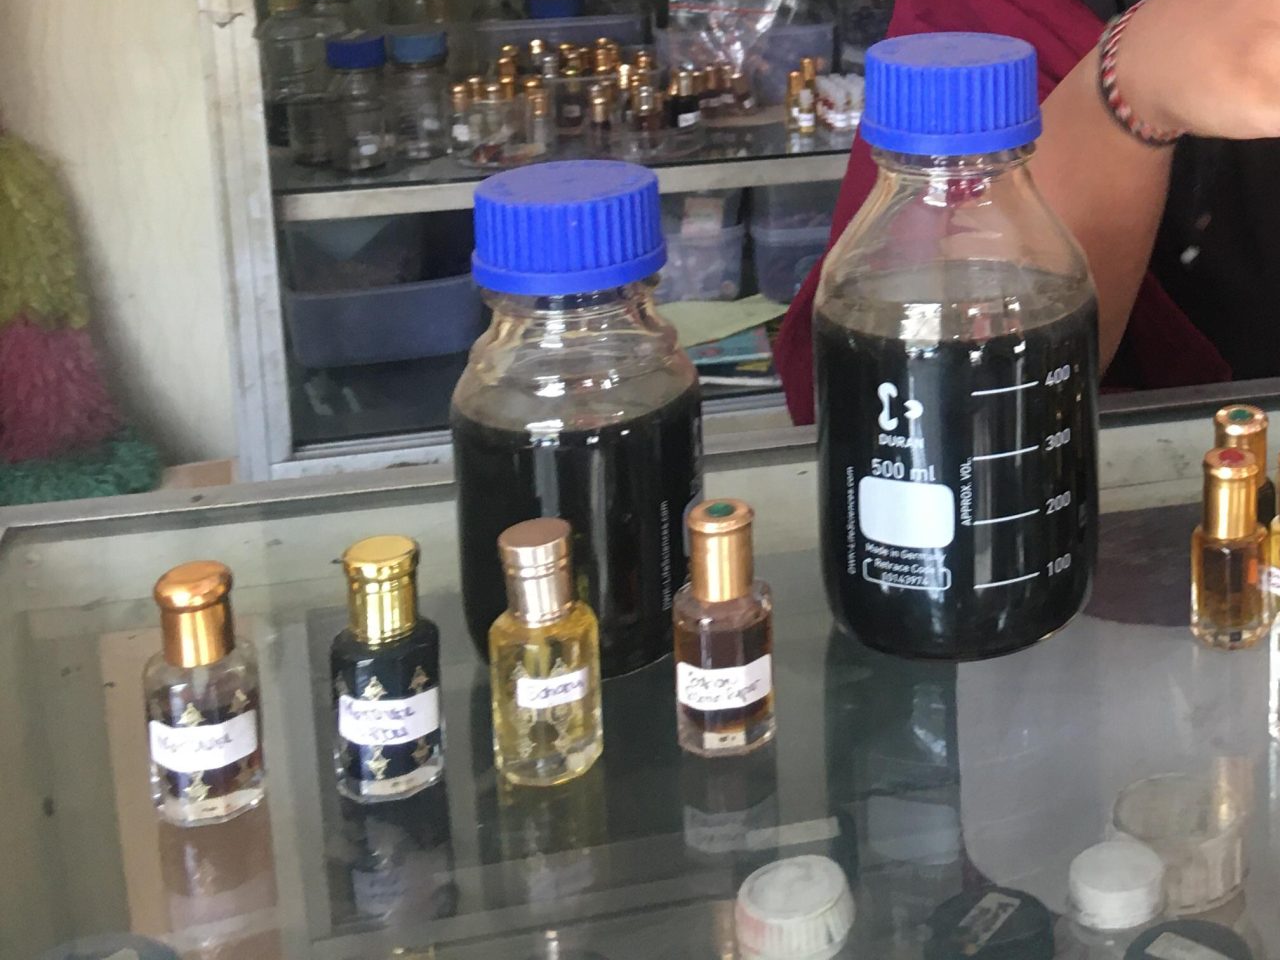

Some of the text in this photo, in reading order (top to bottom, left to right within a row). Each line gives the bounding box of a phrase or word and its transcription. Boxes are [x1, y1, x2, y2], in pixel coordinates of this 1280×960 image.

[1044, 364, 1071, 387] 400
[1044, 427, 1071, 451] 300
[871, 457, 936, 482] 500 ml
[1045, 490, 1071, 515] 200
[1046, 553, 1072, 577] 100
